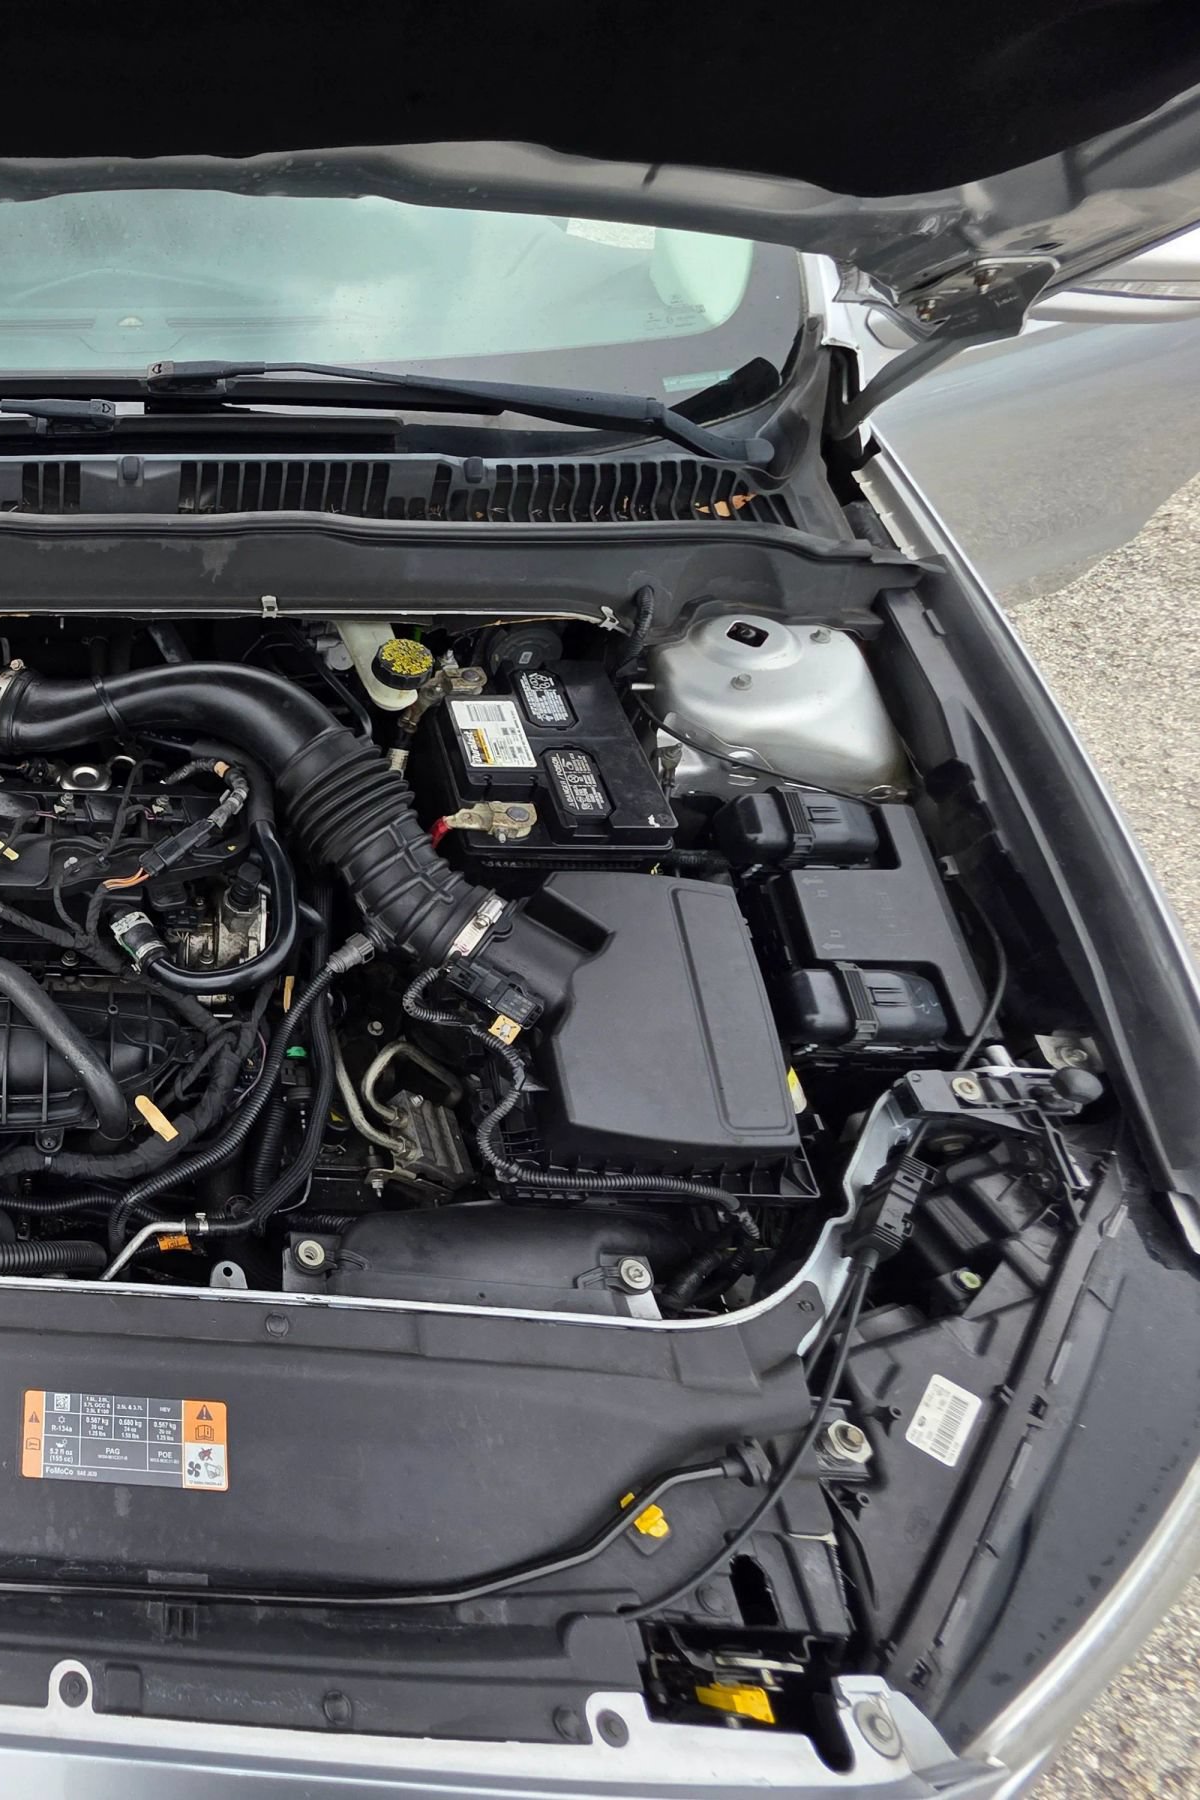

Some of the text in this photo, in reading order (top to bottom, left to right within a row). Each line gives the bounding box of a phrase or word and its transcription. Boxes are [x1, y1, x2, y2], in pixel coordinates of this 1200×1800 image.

[51, 1424, 73, 1432] R-134a
[49, 1447, 59, 1455] 5.2
[105, 1447, 121, 1455] PAG
[157, 1450, 173, 1459] POE
[45, 1466, 74, 1475] FoMoCo
